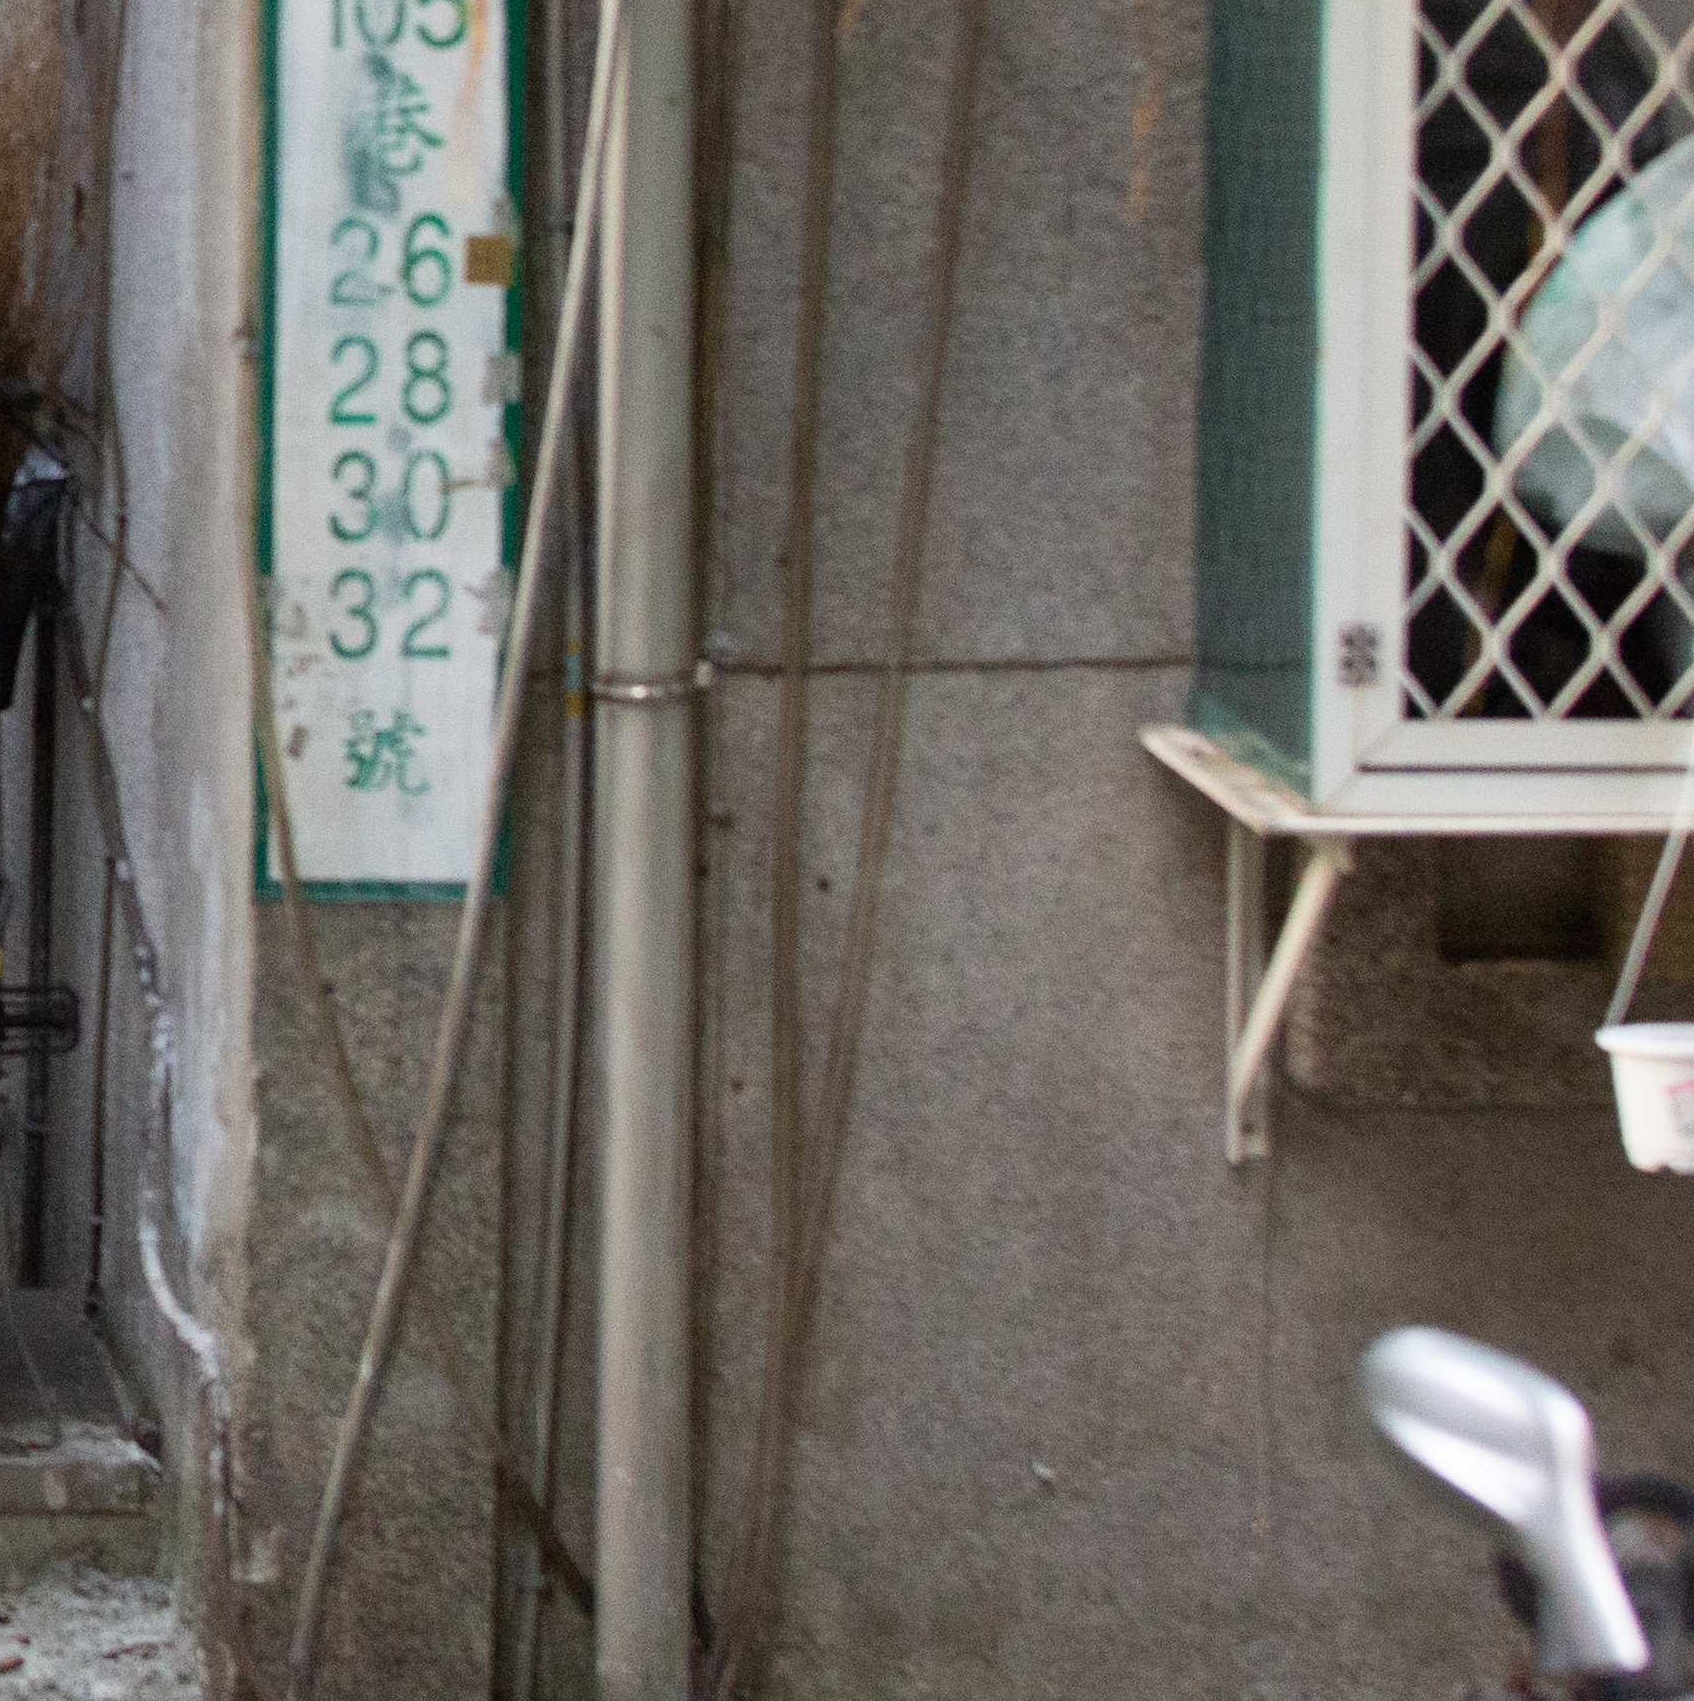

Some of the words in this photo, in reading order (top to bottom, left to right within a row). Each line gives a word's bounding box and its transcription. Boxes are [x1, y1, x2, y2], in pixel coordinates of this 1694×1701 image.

[328, 211, 455, 309] 26
[327, 329, 455, 427] 28
[328, 449, 454, 545] 30
[327, 567, 453, 663] 32
